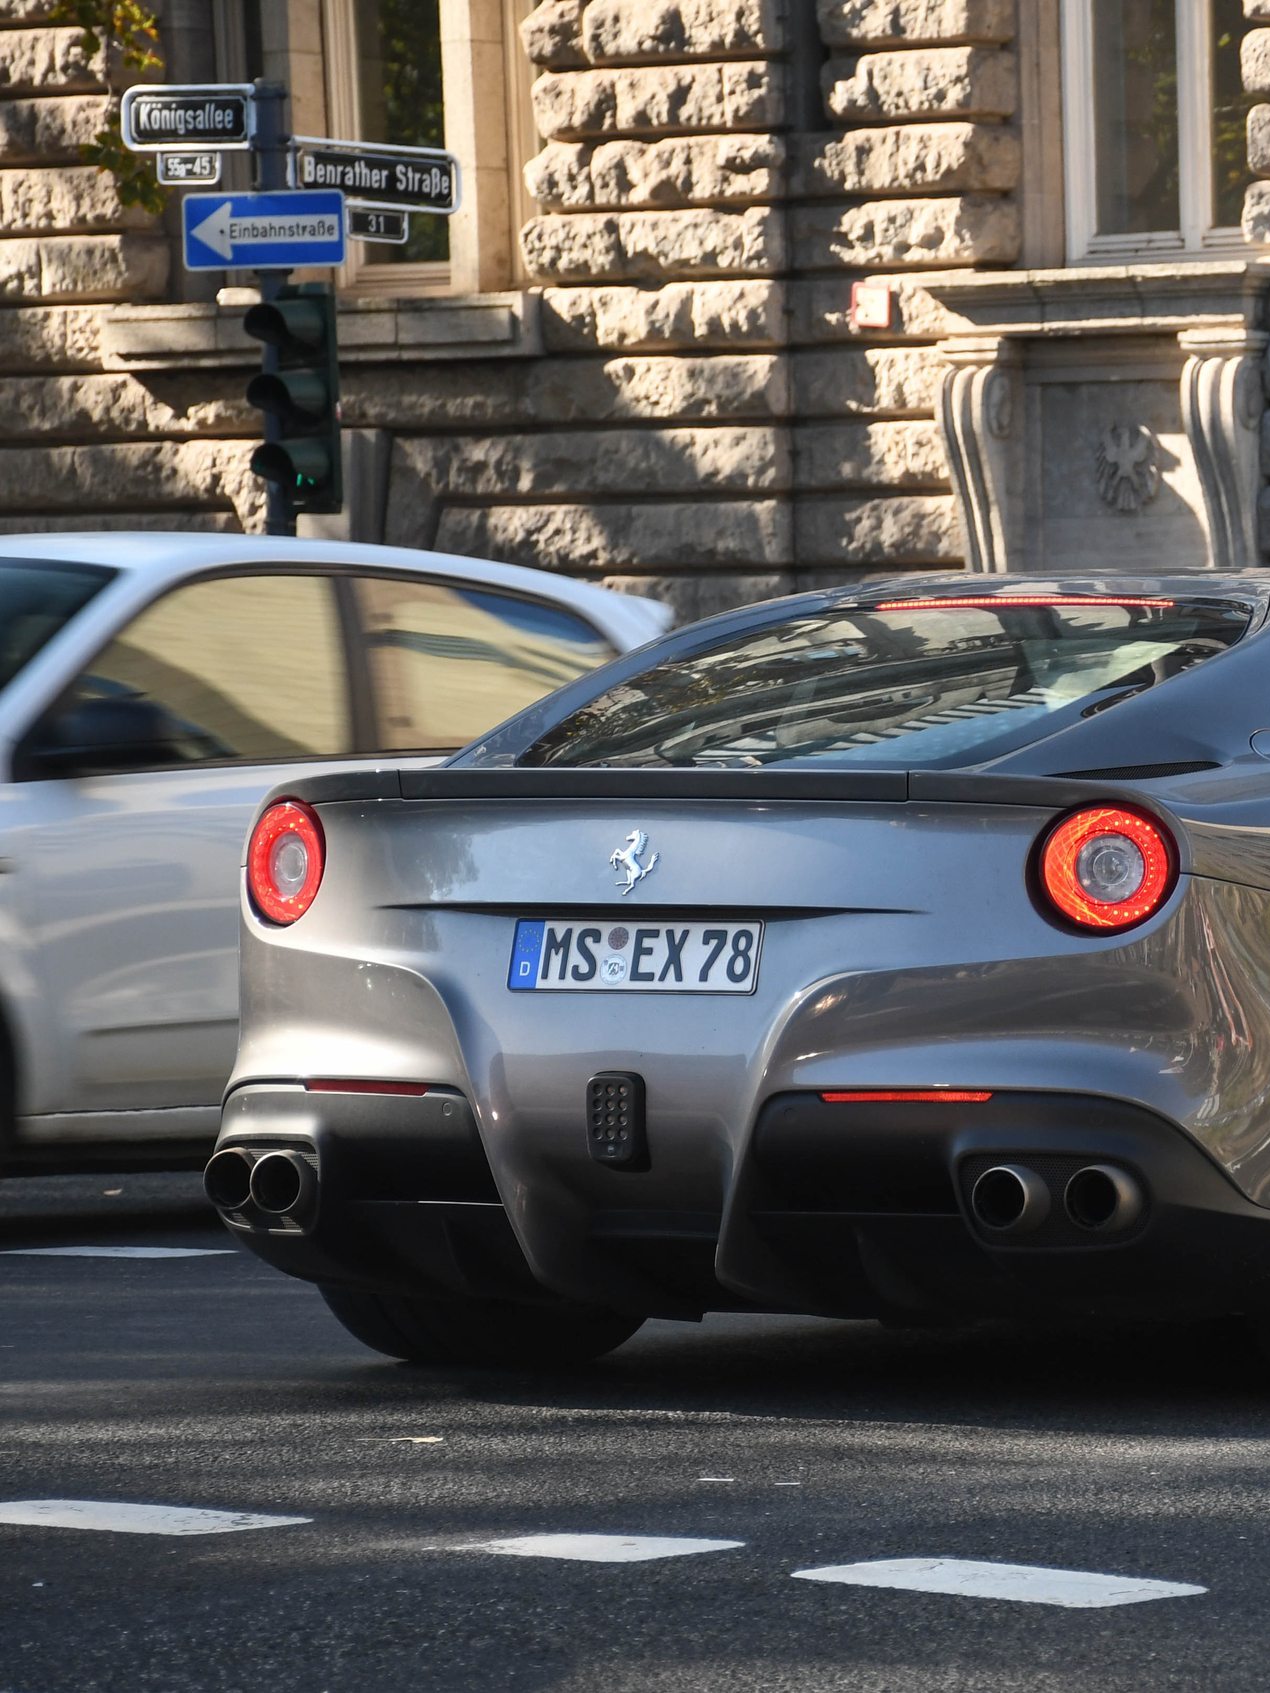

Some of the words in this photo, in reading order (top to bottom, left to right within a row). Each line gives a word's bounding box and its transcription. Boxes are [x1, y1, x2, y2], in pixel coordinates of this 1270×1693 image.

[140, 103, 234, 135] Königsallee
[303, 156, 389, 189] Benrather
[395, 166, 449, 198] Straße
[229, 220, 335, 240] Einbahnstraße
[367, 214, 385, 233] 31
[540, 927, 602, 982] MS
[629, 929, 690, 983] EX
[698, 929, 754, 984] 78
[518, 961, 531, 978] D
